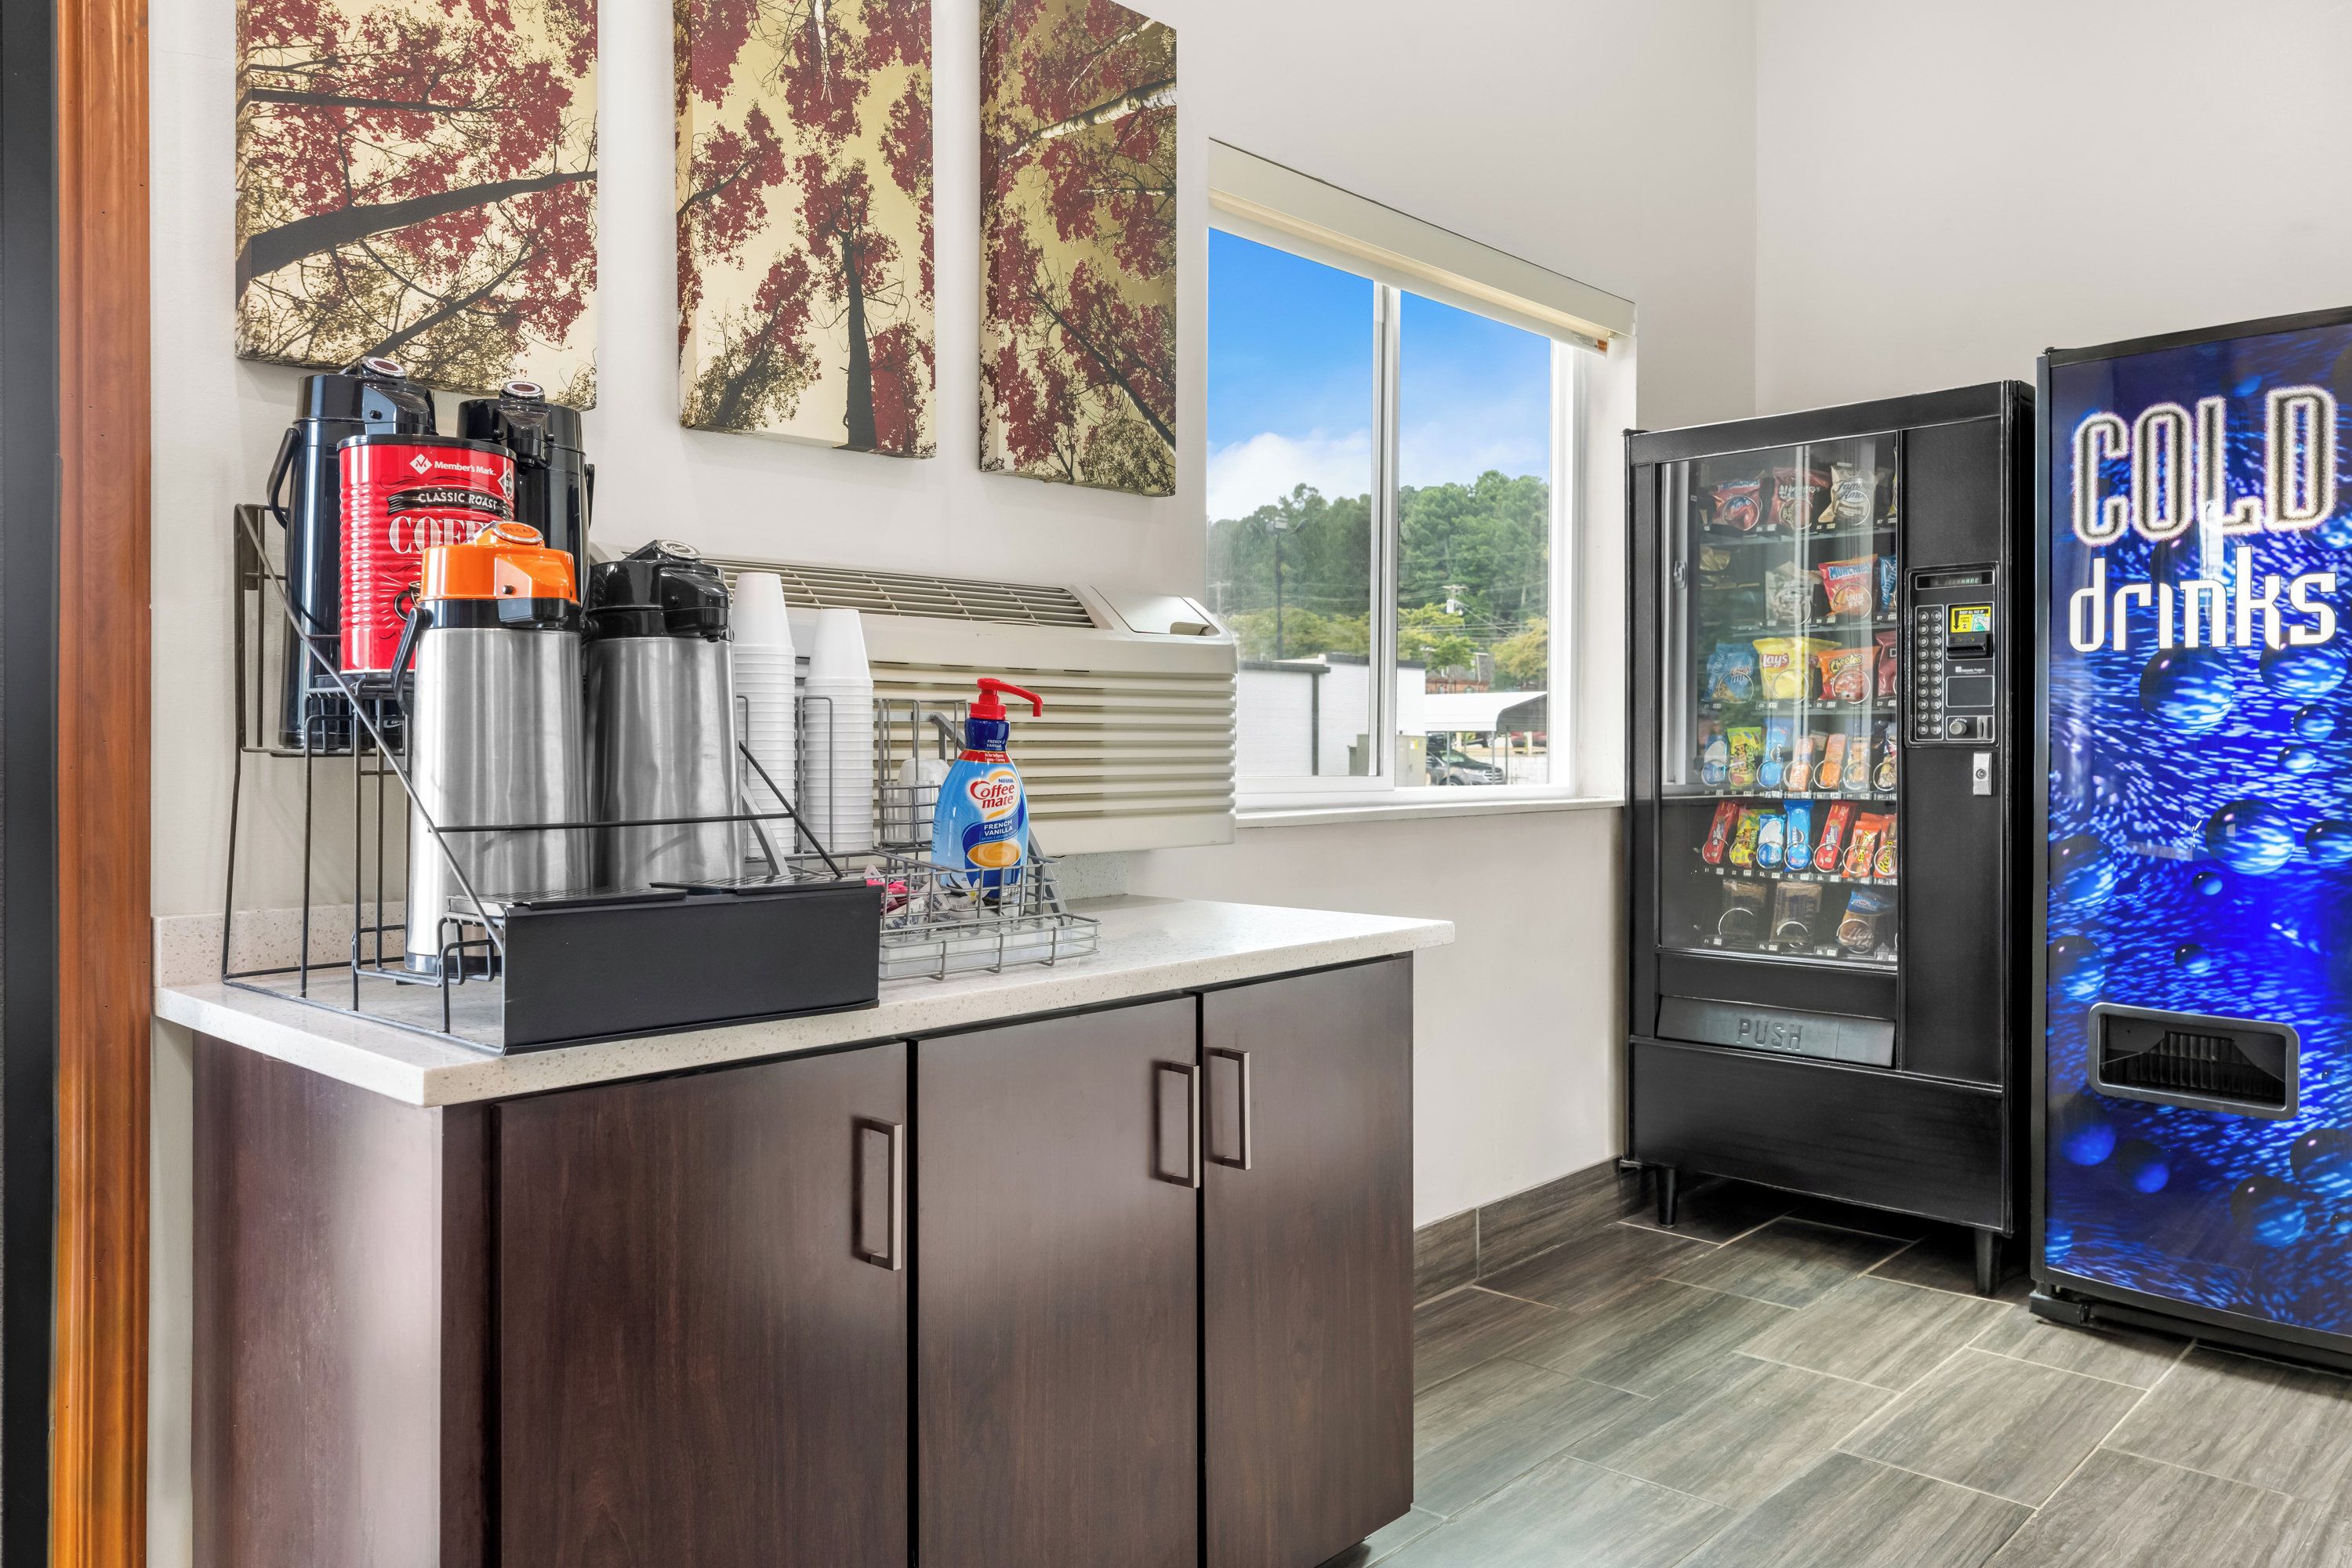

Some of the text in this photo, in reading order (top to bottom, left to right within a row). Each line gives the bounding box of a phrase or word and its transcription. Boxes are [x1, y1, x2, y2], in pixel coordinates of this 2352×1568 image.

[434, 461, 494, 476] Member's Mark
[2071, 384, 2339, 547] COLD
[418, 492, 498, 510] CLASSIC ROAST
[1828, 563, 1871, 580] MUNCHIES
[2069, 546, 2338, 652] drinks
[1762, 652, 1788, 668] Lay's
[1830, 654, 1863, 674] Cheetos
[970, 780, 1014, 800] Coffee
[982, 795, 1014, 808] mate
[984, 819, 1012, 830] FRENCH
[984, 826, 1013, 837] VANILLA
[1736, 1018, 1804, 1051] PUSH
